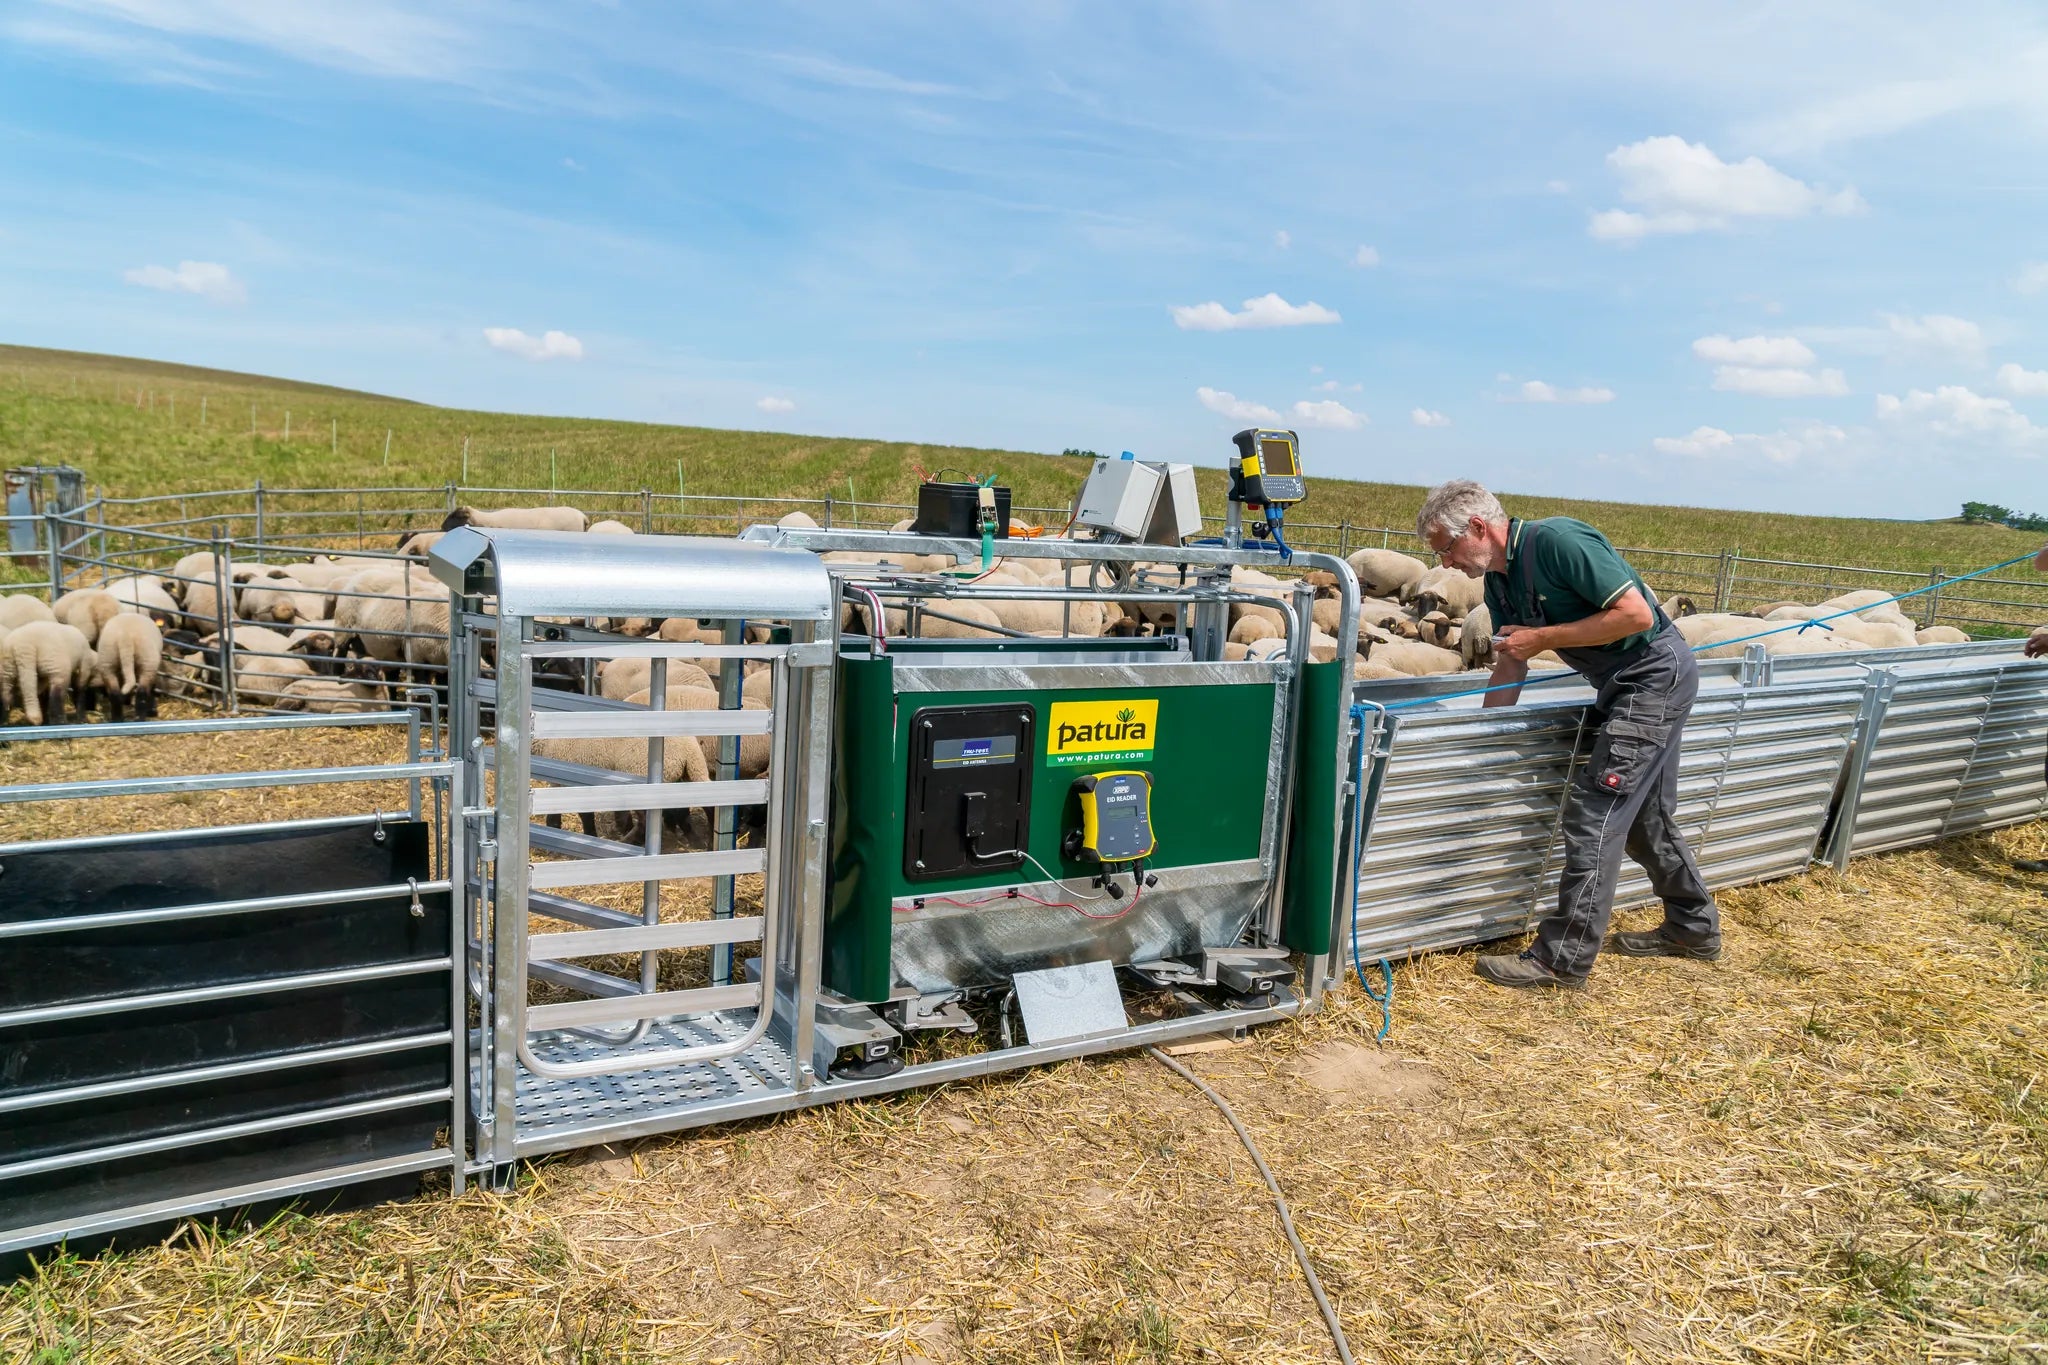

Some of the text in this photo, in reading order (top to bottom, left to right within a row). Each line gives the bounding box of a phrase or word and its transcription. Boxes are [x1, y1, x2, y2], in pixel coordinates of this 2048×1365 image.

[1057, 721, 1146, 750] patura
[1057, 752, 1144, 763] www.patura.com
[1116, 794, 1137, 802] READER
